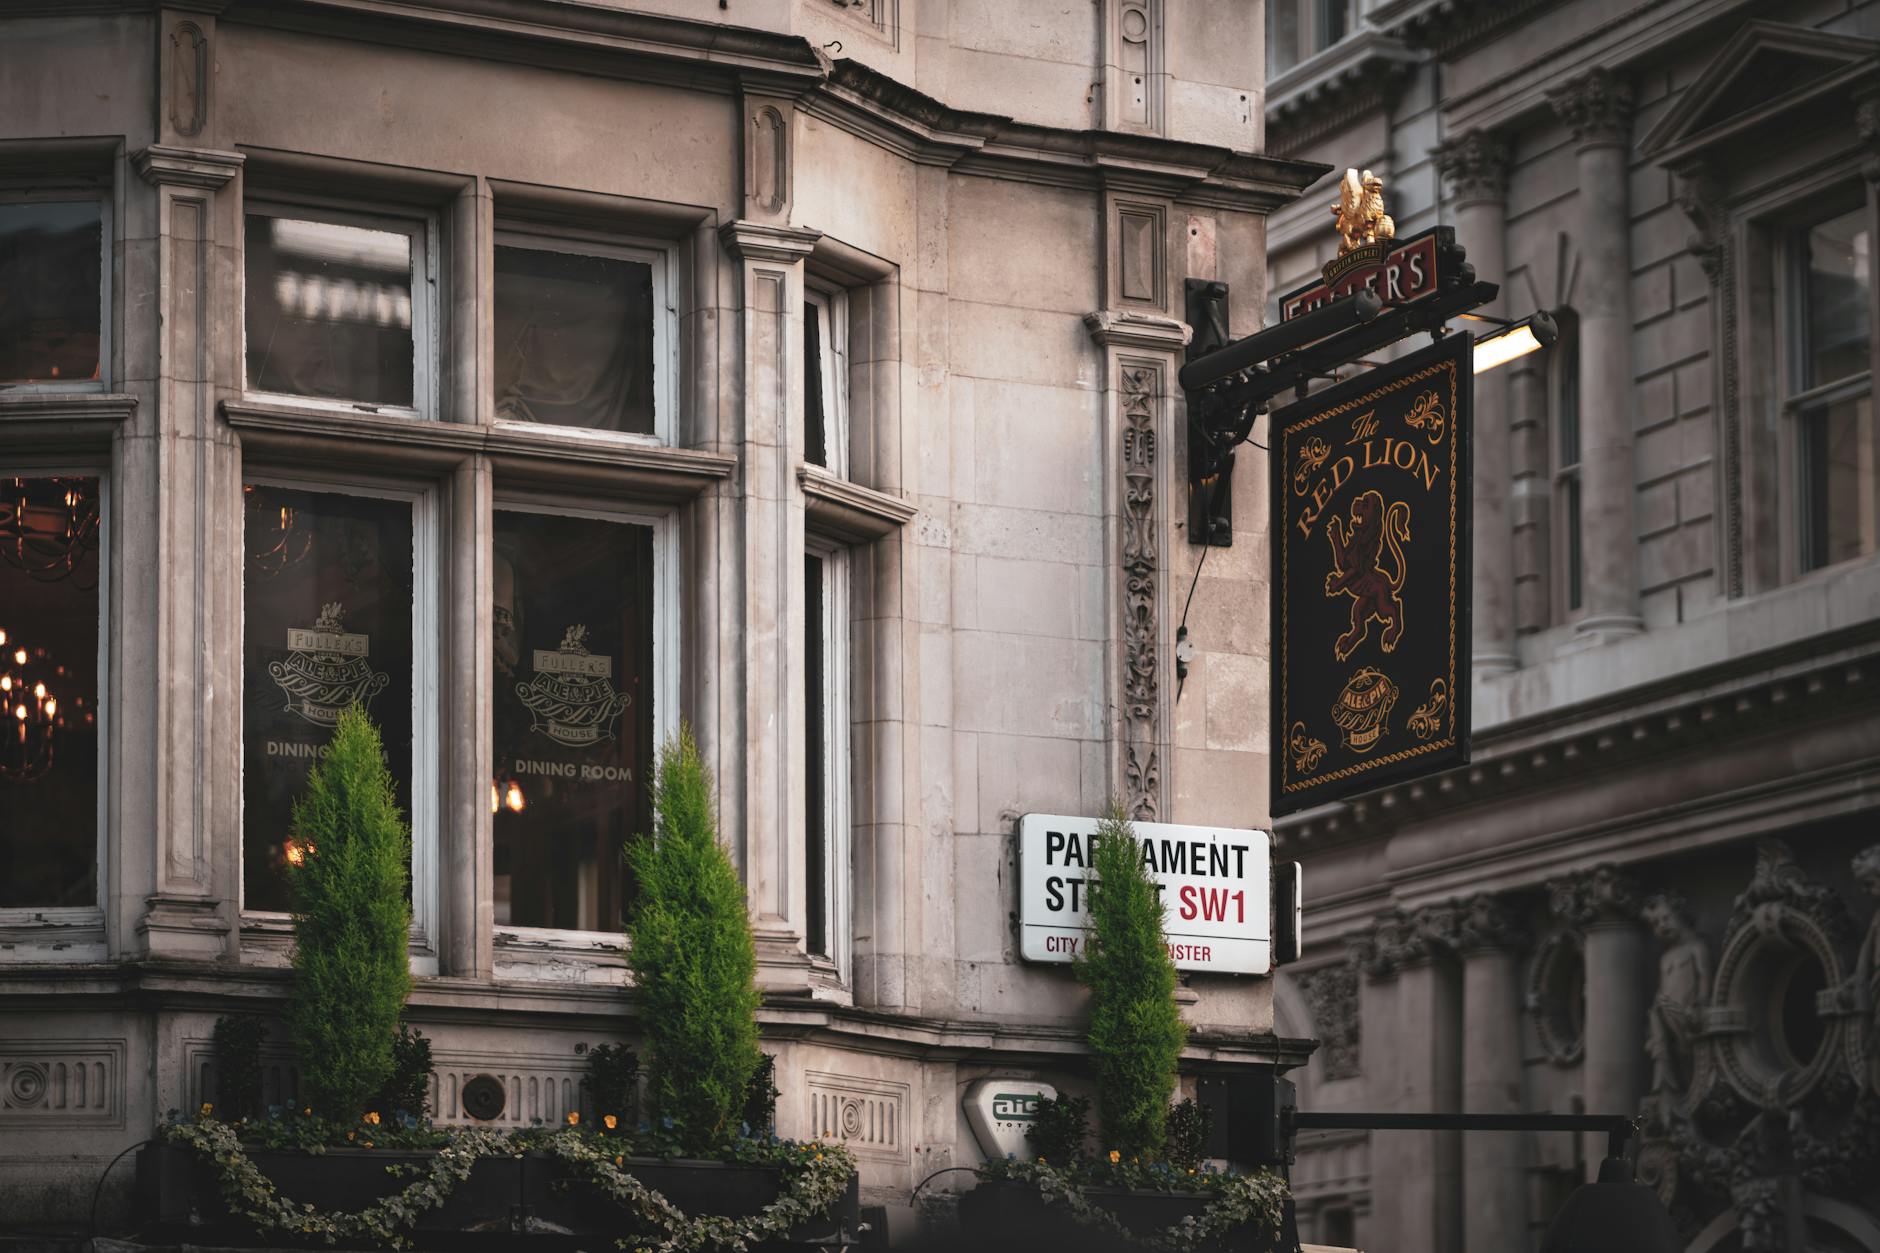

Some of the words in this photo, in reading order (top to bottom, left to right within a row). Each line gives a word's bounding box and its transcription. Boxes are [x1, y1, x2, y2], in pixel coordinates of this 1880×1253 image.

[1288, 251, 1425, 320] FER'S
[1345, 409, 1380, 446] The
[1296, 455, 1355, 541] RED
[1362, 438, 1440, 492] LION
[295, 634, 362, 652] FULLER'S
[541, 655, 606, 672] FULLER'S
[308, 706, 340, 719] HOUS
[554, 726, 593, 739] HOUSE
[1353, 731, 1378, 744] HOUSE
[515, 760, 576, 777] DINING
[581, 764, 632, 781] ROOM
[1046, 831, 1249, 879] PAAMENT
[1046, 876, 1166, 914] STT
[1179, 885, 1245, 923] SW1
[1046, 936, 1079, 953] CITY
